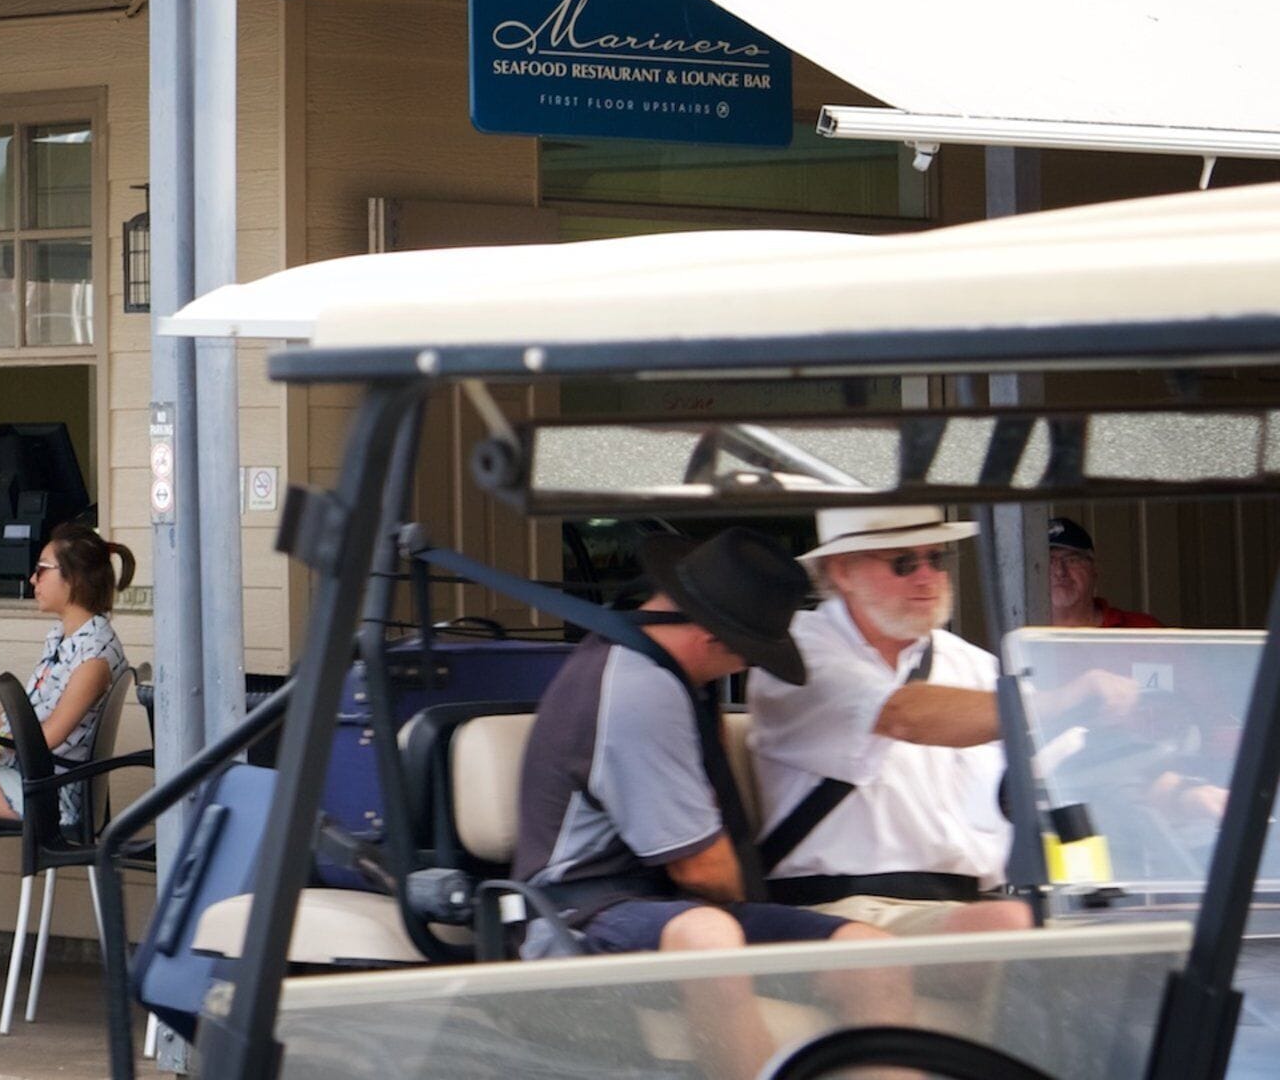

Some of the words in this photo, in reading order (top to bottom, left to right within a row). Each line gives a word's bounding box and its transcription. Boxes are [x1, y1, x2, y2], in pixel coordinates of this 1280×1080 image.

[493, 59, 567, 78] SEAFOOD
[572, 63, 661, 84] RESTAURANT
[665, 69, 677, 85] &
[682, 70, 740, 88] LOUNGE
[744, 73, 771, 89] BAR
[540, 94, 579, 107] FIRST
[588, 97, 635, 111] FLOOR
[643, 100, 711, 115] UPSTAIRS
